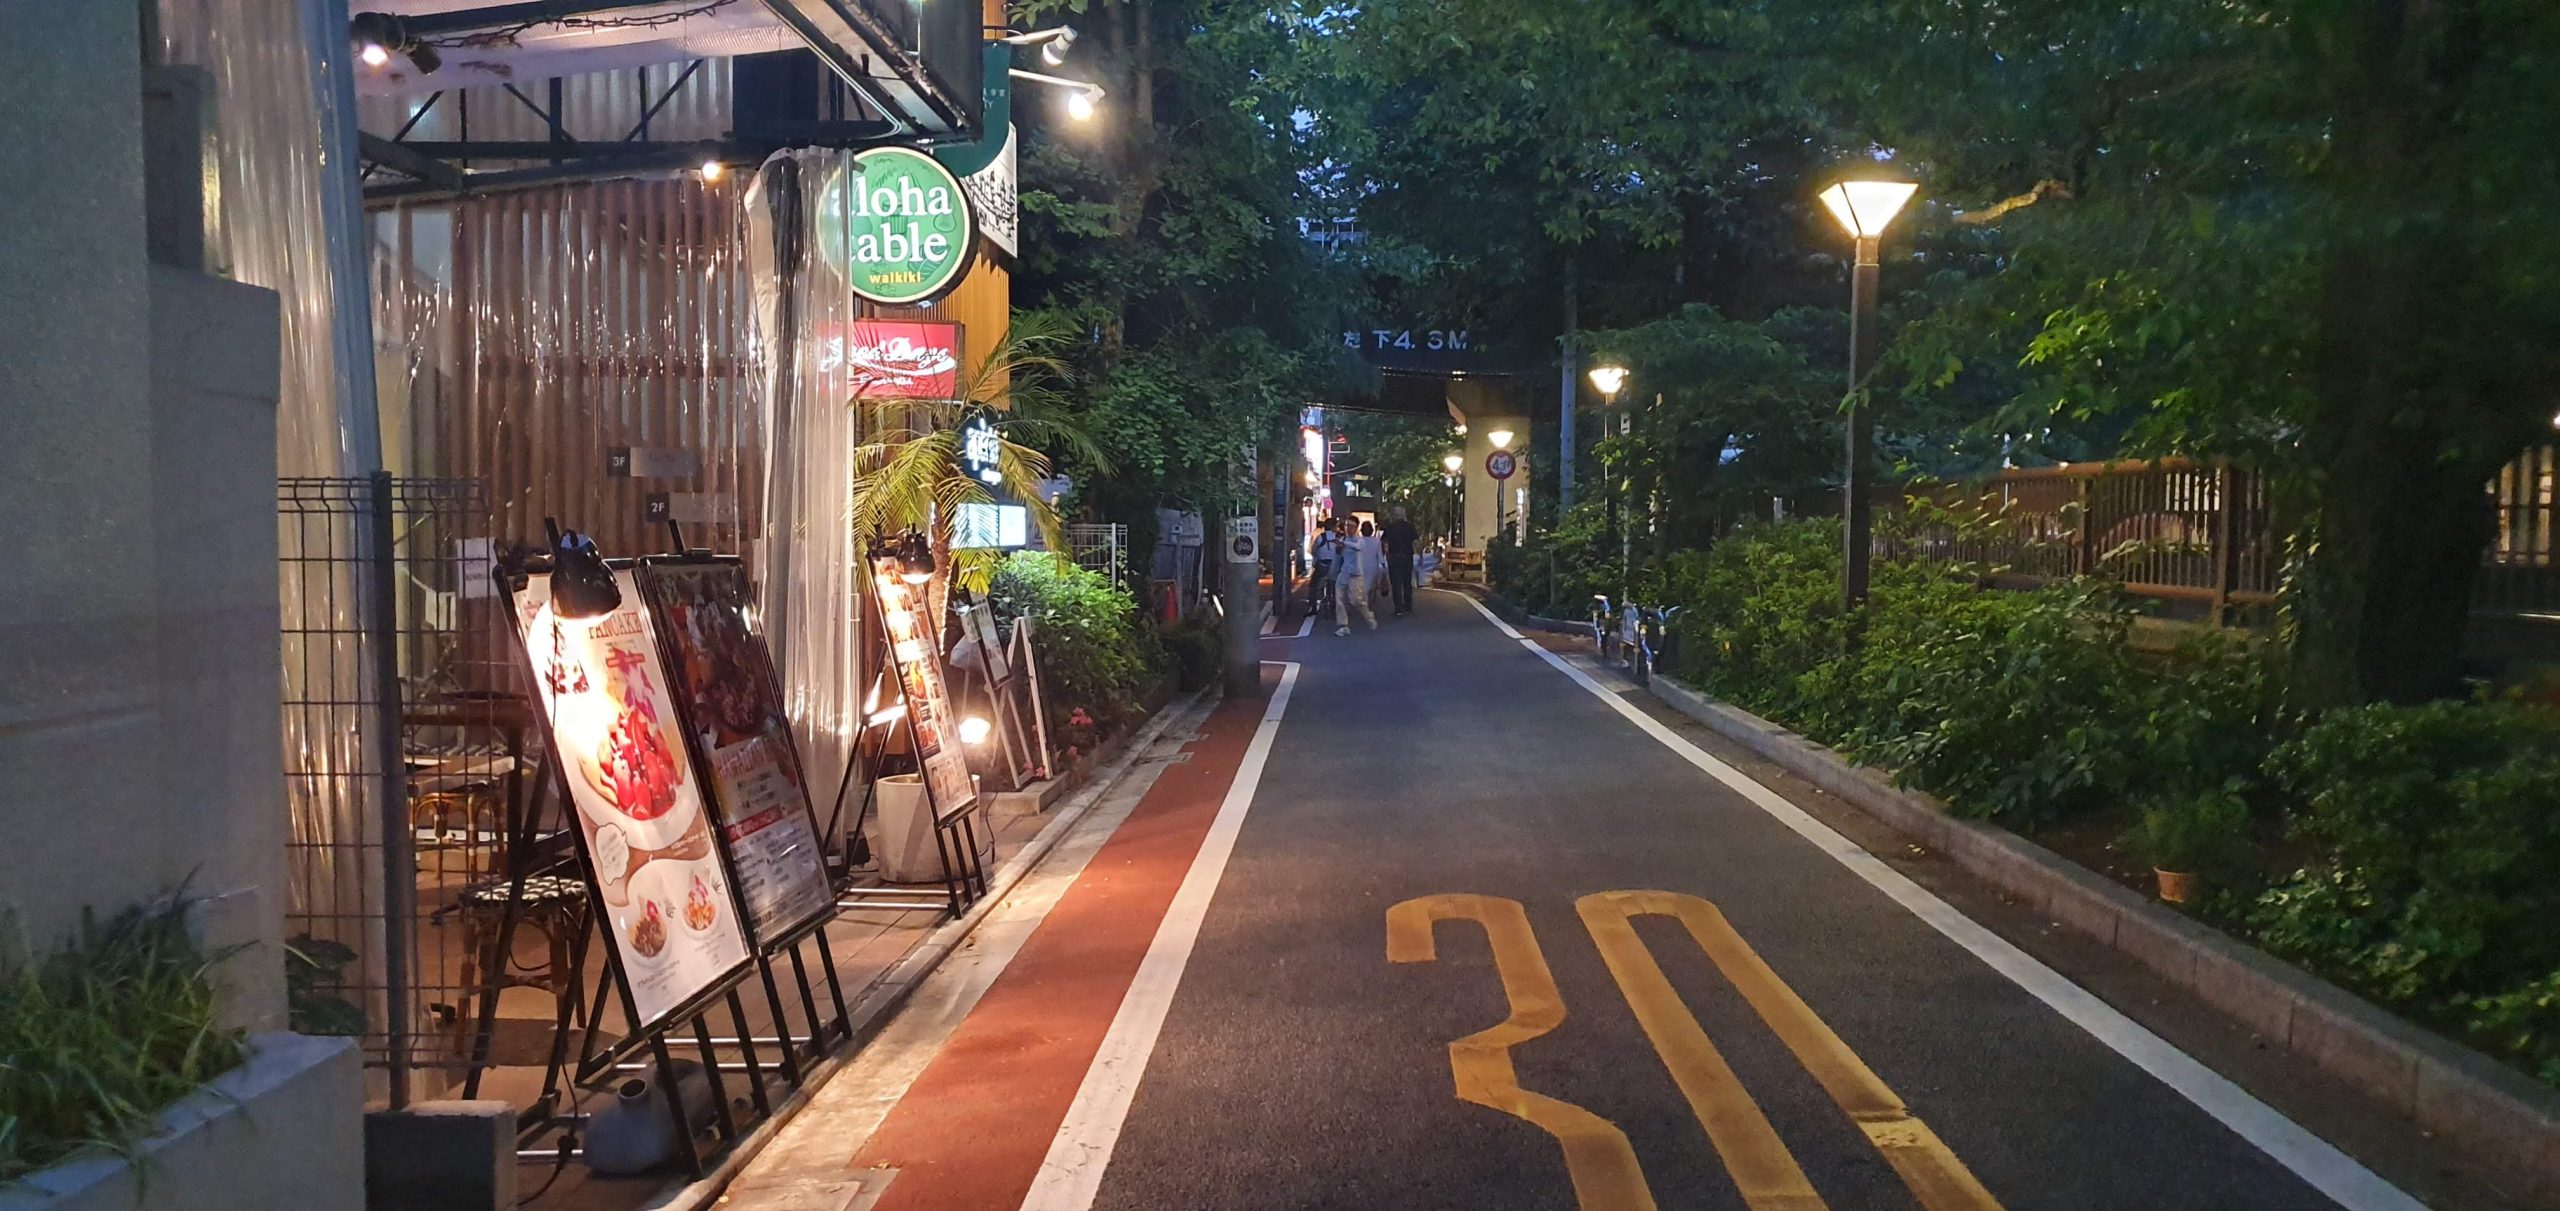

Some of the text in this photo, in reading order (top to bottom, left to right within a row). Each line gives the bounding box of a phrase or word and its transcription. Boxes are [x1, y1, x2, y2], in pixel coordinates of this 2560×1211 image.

[851, 222, 949, 263] able
[869, 271, 921, 284] waikiki
[612, 456, 626, 467] 3F
[651, 502, 665, 513] 2F
[1386, 889, 2003, 1211] 30
